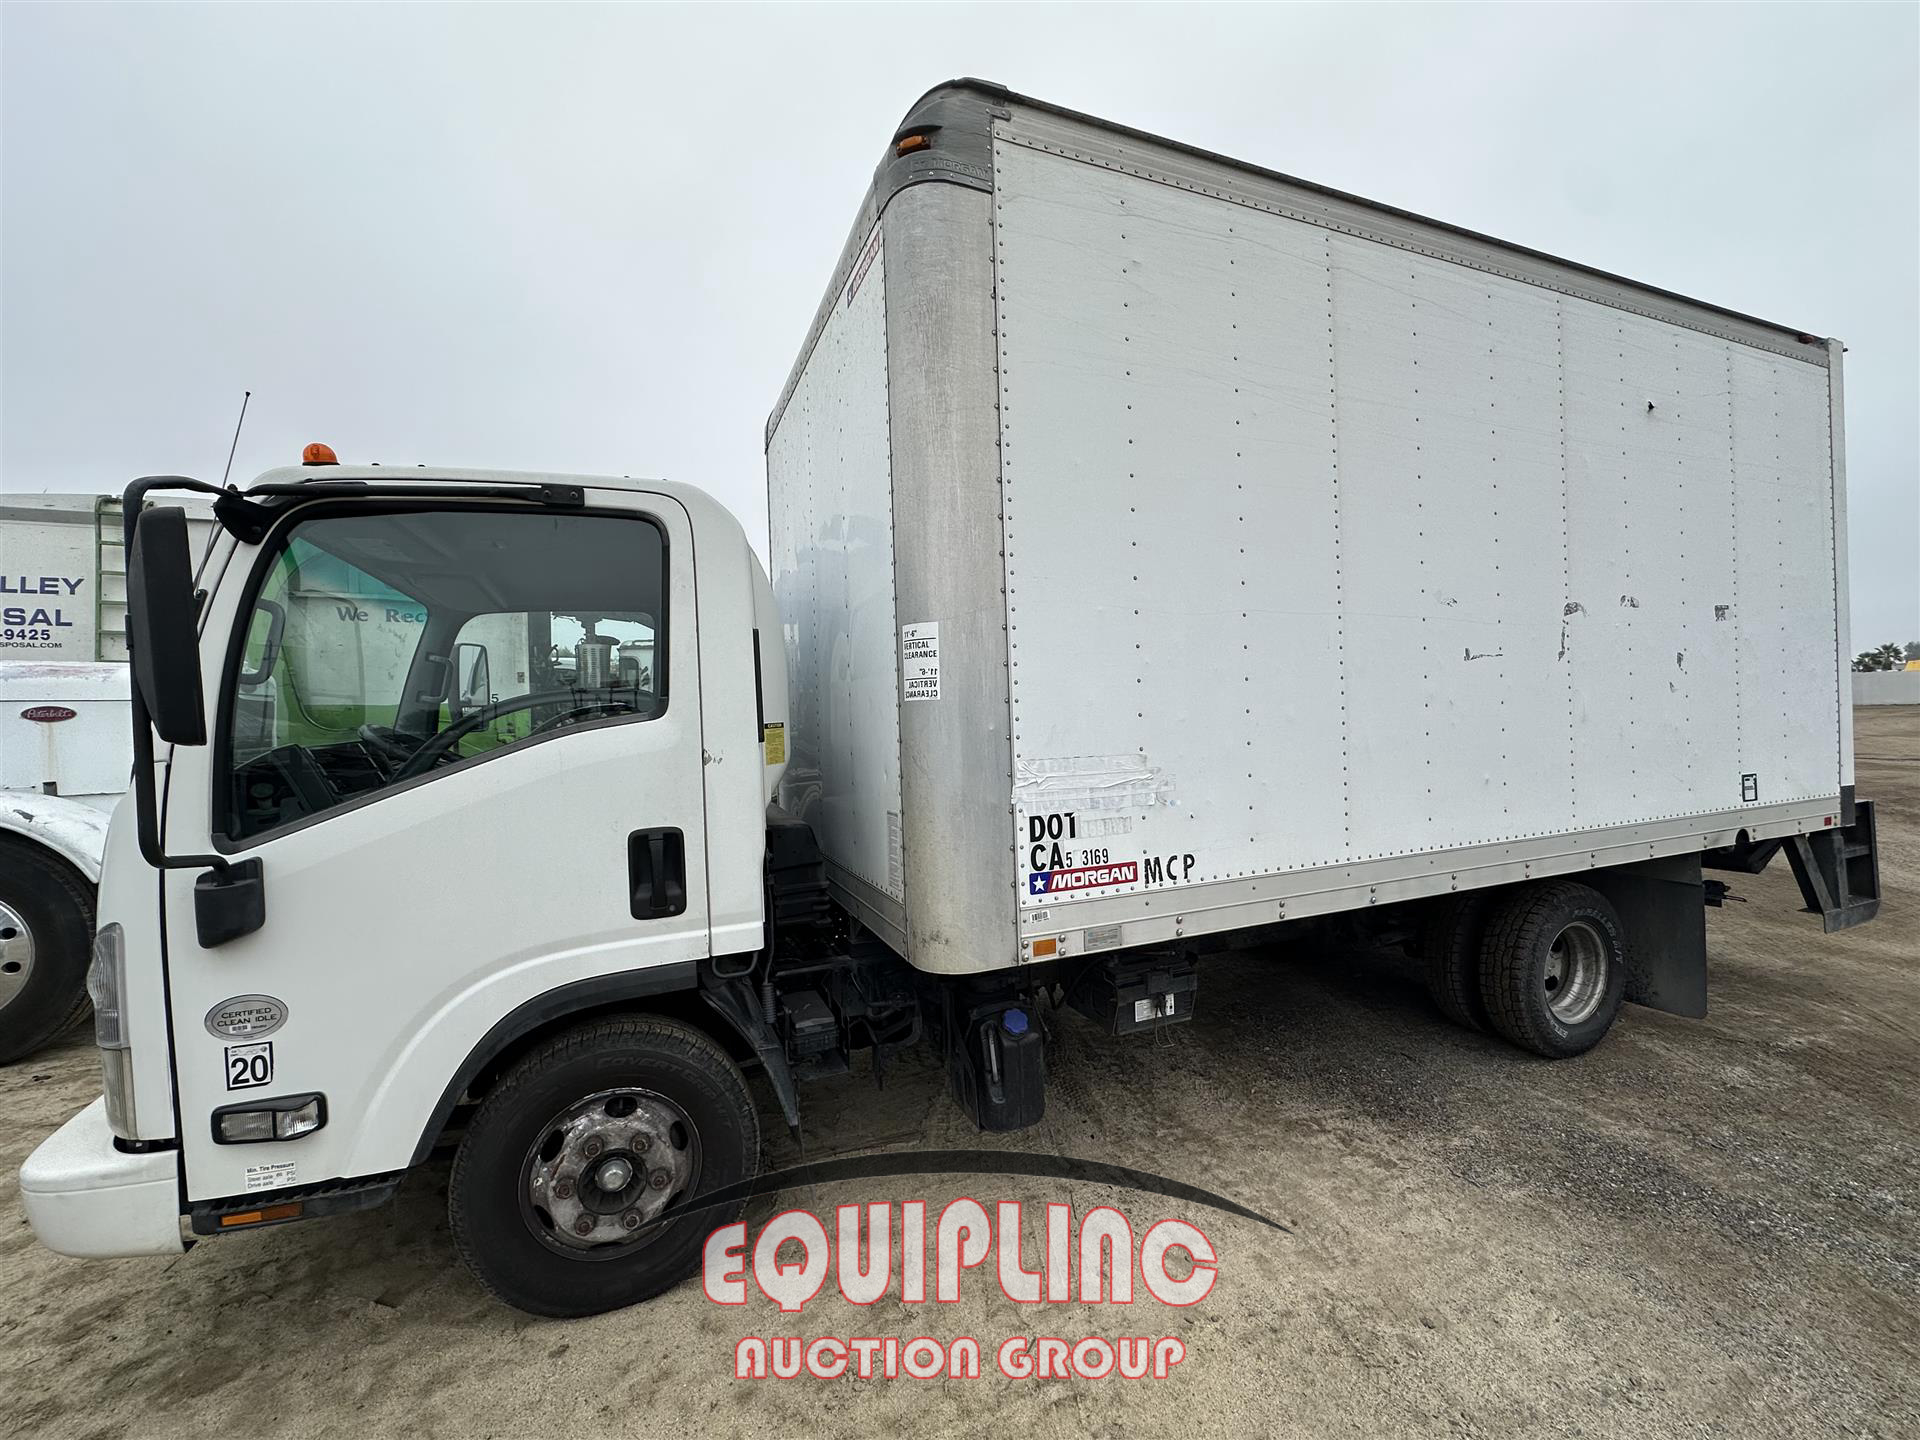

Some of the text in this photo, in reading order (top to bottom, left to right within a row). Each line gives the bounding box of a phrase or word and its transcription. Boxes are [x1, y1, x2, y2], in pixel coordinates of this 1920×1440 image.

[932, 157, 986, 178] MORGAN
[0, 607, 73, 627] SAL
[336, 606, 428, 623] We Rec
[904, 641, 929, 650] VERTICAL
[904, 650, 937, 660] CLEARANCE
[1029, 812, 1076, 842] DOT
[1030, 842, 1064, 872] CA
[1082, 848, 1109, 866] 3169
[1051, 866, 1136, 890] MORGAN
[1144, 853, 1195, 885] MCP
[217, 1017, 251, 1028] CLEAN
[255, 1013, 278, 1023] IDLE
[221, 1007, 272, 1019] CERTIFIED
[231, 1054, 269, 1086] 20
[271, 1162, 295, 1170] Pressure
